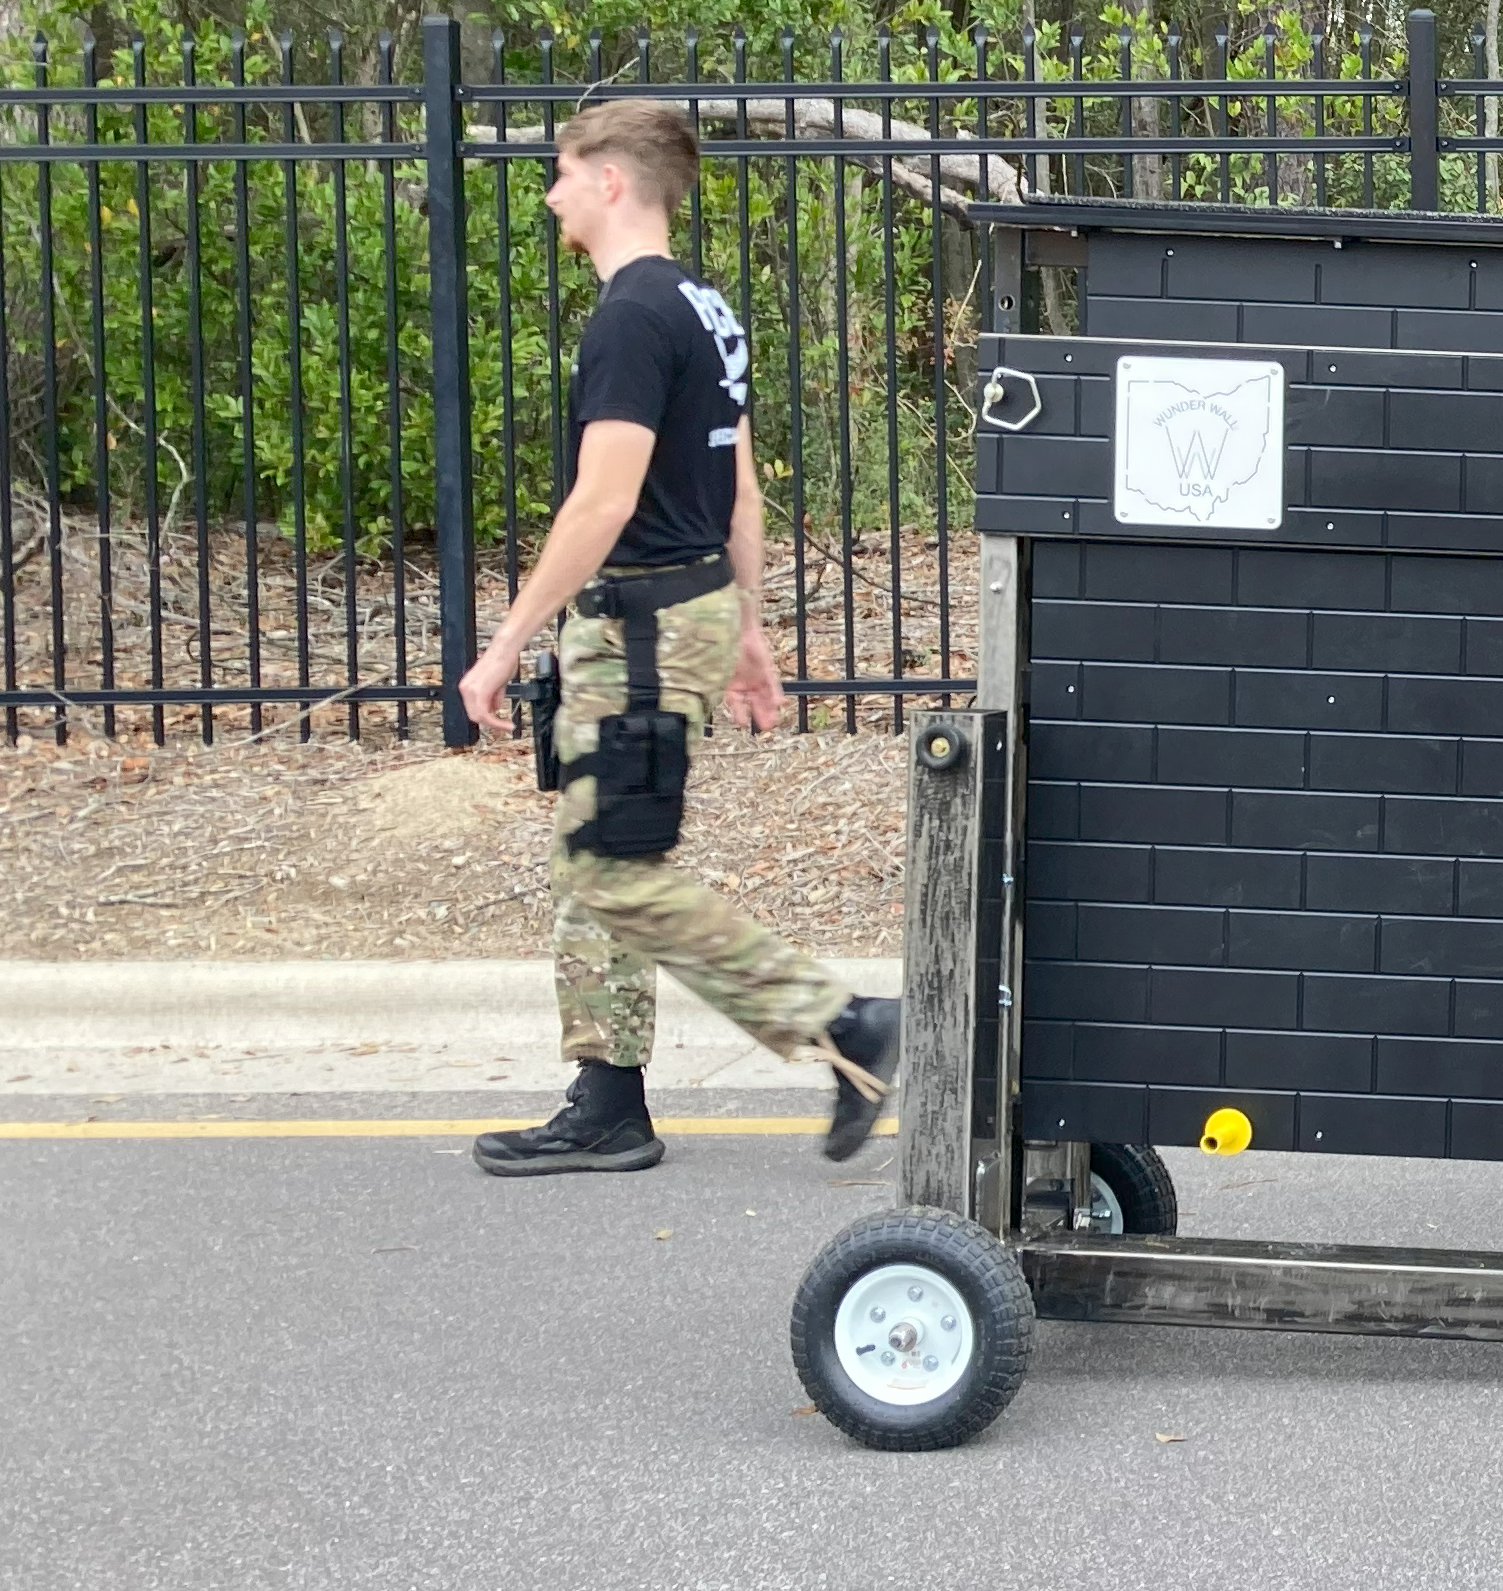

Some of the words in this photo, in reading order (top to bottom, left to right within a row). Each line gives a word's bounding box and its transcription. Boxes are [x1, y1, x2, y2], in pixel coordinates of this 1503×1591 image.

[1153, 400, 1206, 428] WUNDER
[1210, 403, 1239, 431] WALL
[1179, 483, 1214, 498] USA
